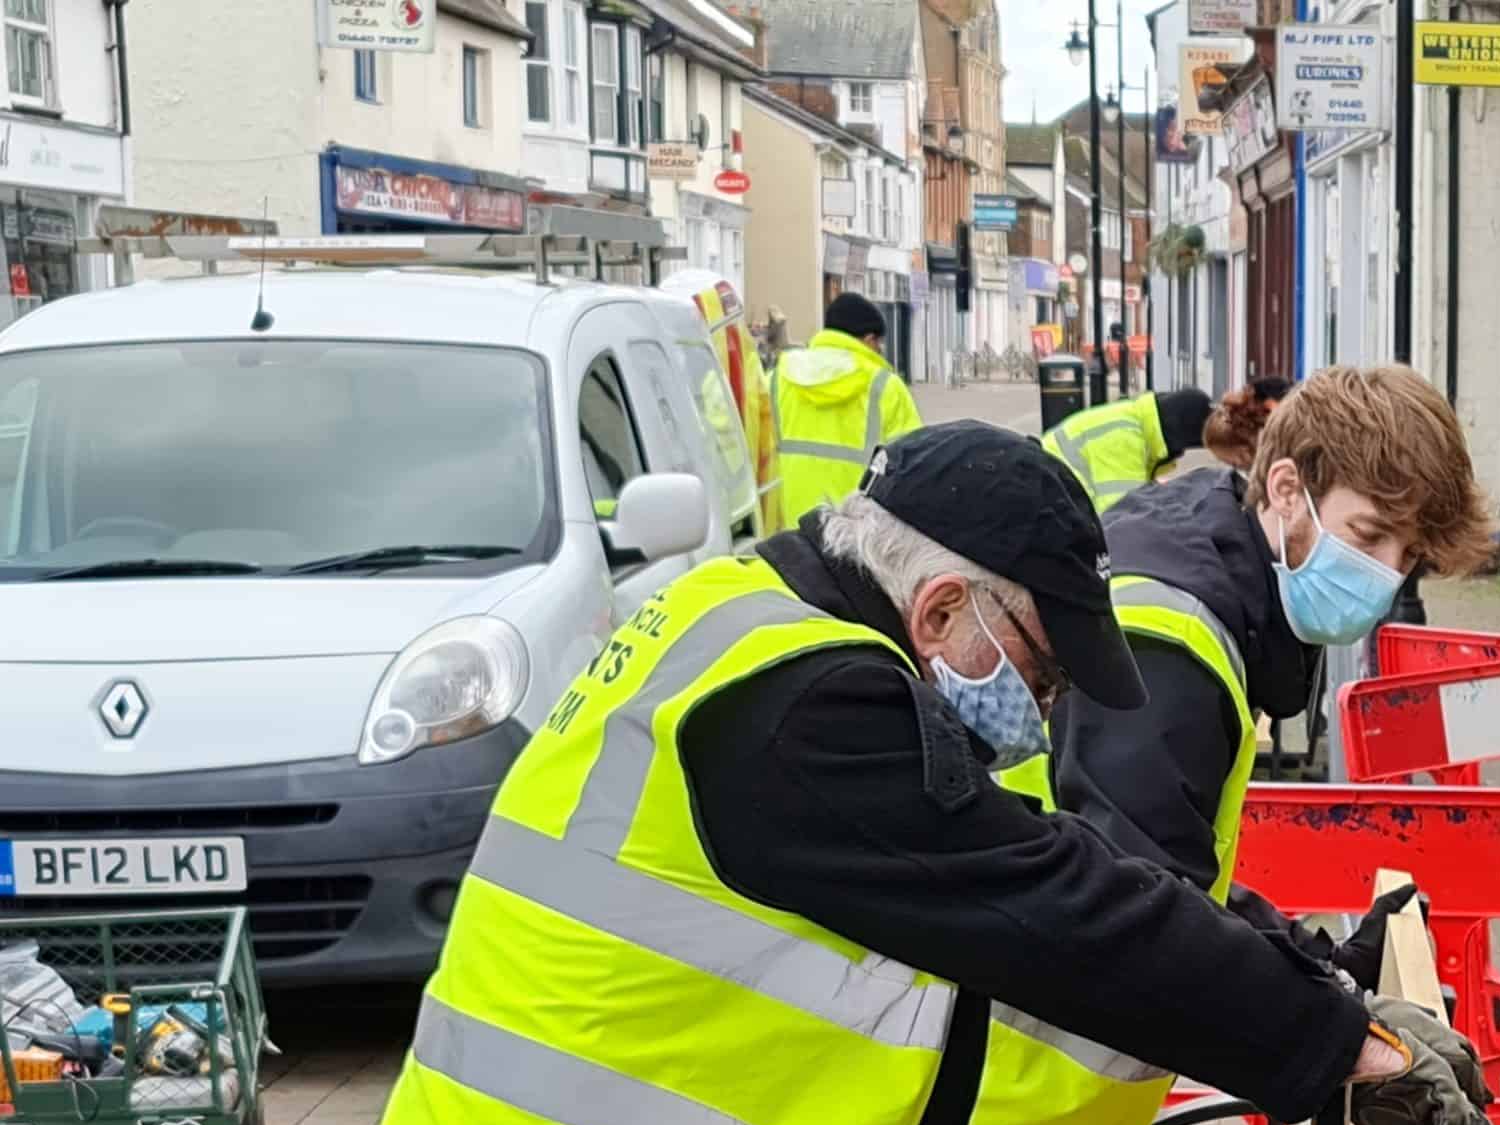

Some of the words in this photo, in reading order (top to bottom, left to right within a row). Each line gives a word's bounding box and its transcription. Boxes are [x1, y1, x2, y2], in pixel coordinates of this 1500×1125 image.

[1313, 34, 1344, 45] PIPE
[1347, 34, 1375, 45] LTD
[1298, 67, 1361, 79] EURONICS
[33, 847, 129, 884] BF12
[143, 845, 228, 883] LKD
